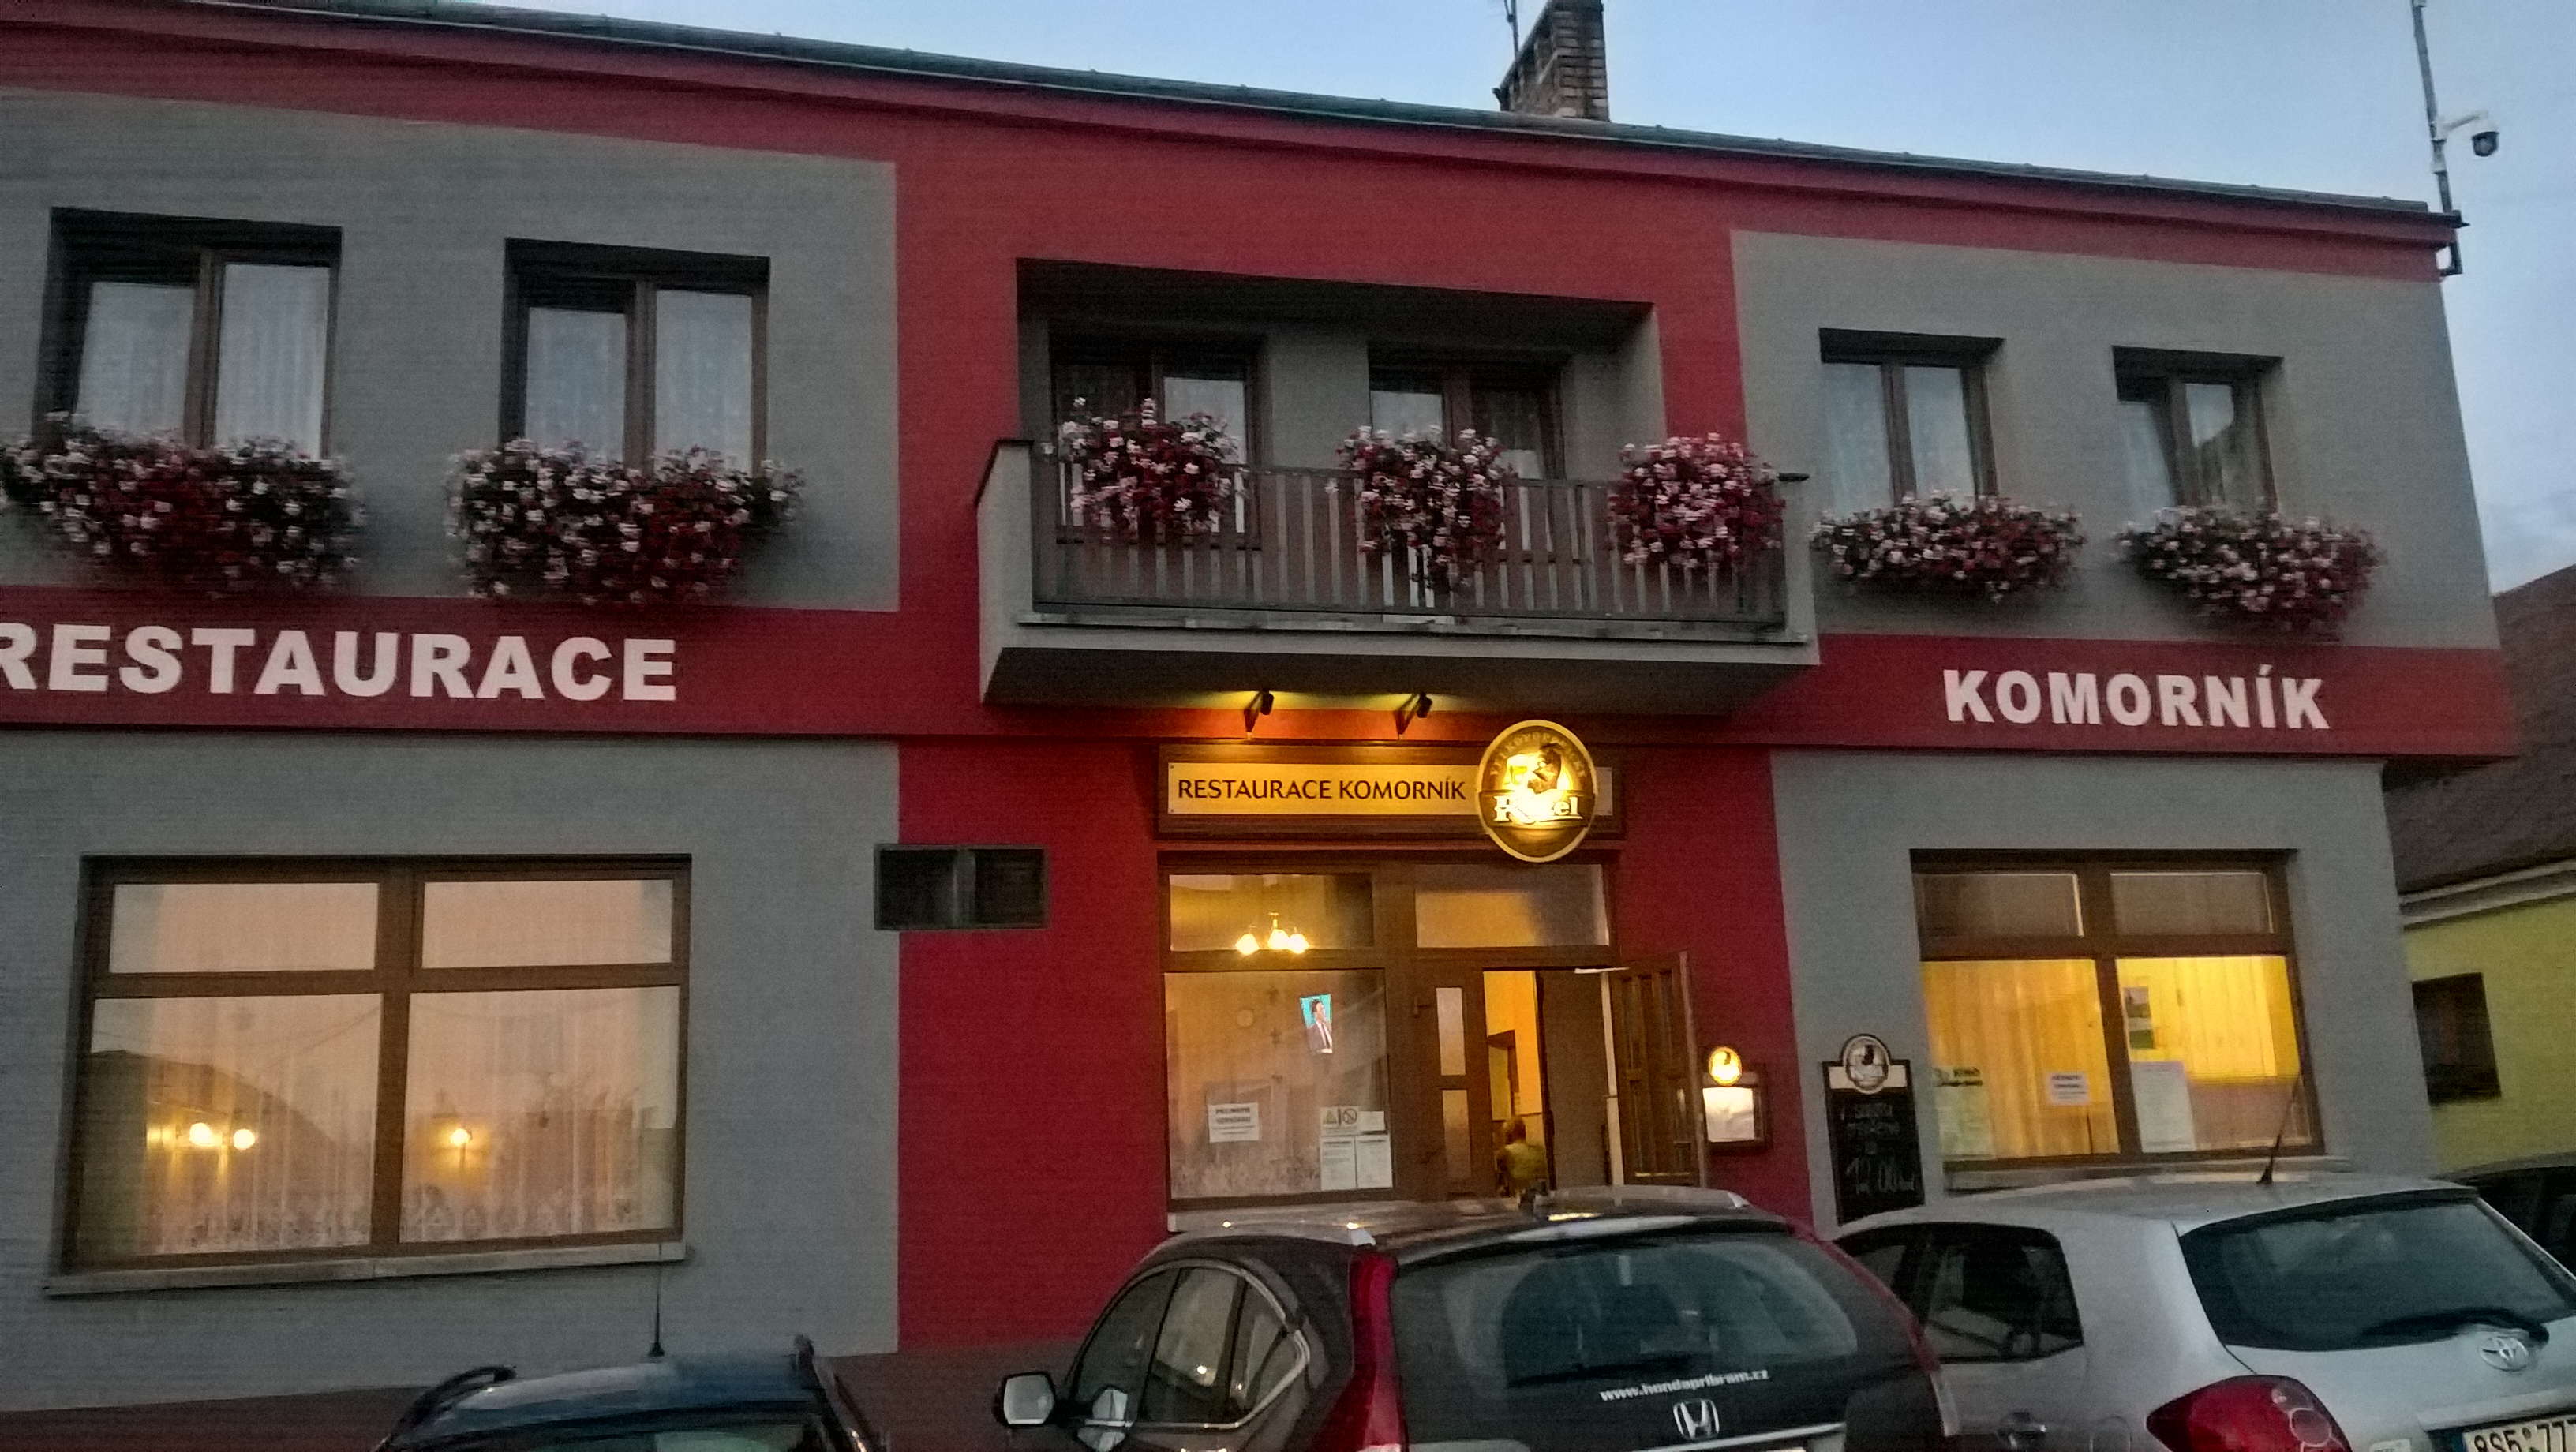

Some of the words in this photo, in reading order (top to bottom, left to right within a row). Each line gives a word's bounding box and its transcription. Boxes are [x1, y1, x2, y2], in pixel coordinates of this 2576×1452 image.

[0, 622, 677, 701] RESTAURACE
[1942, 663, 2331, 730] KOMORNÍK
[1178, 779, 1332, 799] RESTAURACE
[1339, 775, 1466, 800] KOMORNÍK
[1493, 794, 1583, 825] Kel
[2536, 1419, 2576, 1452] 77
